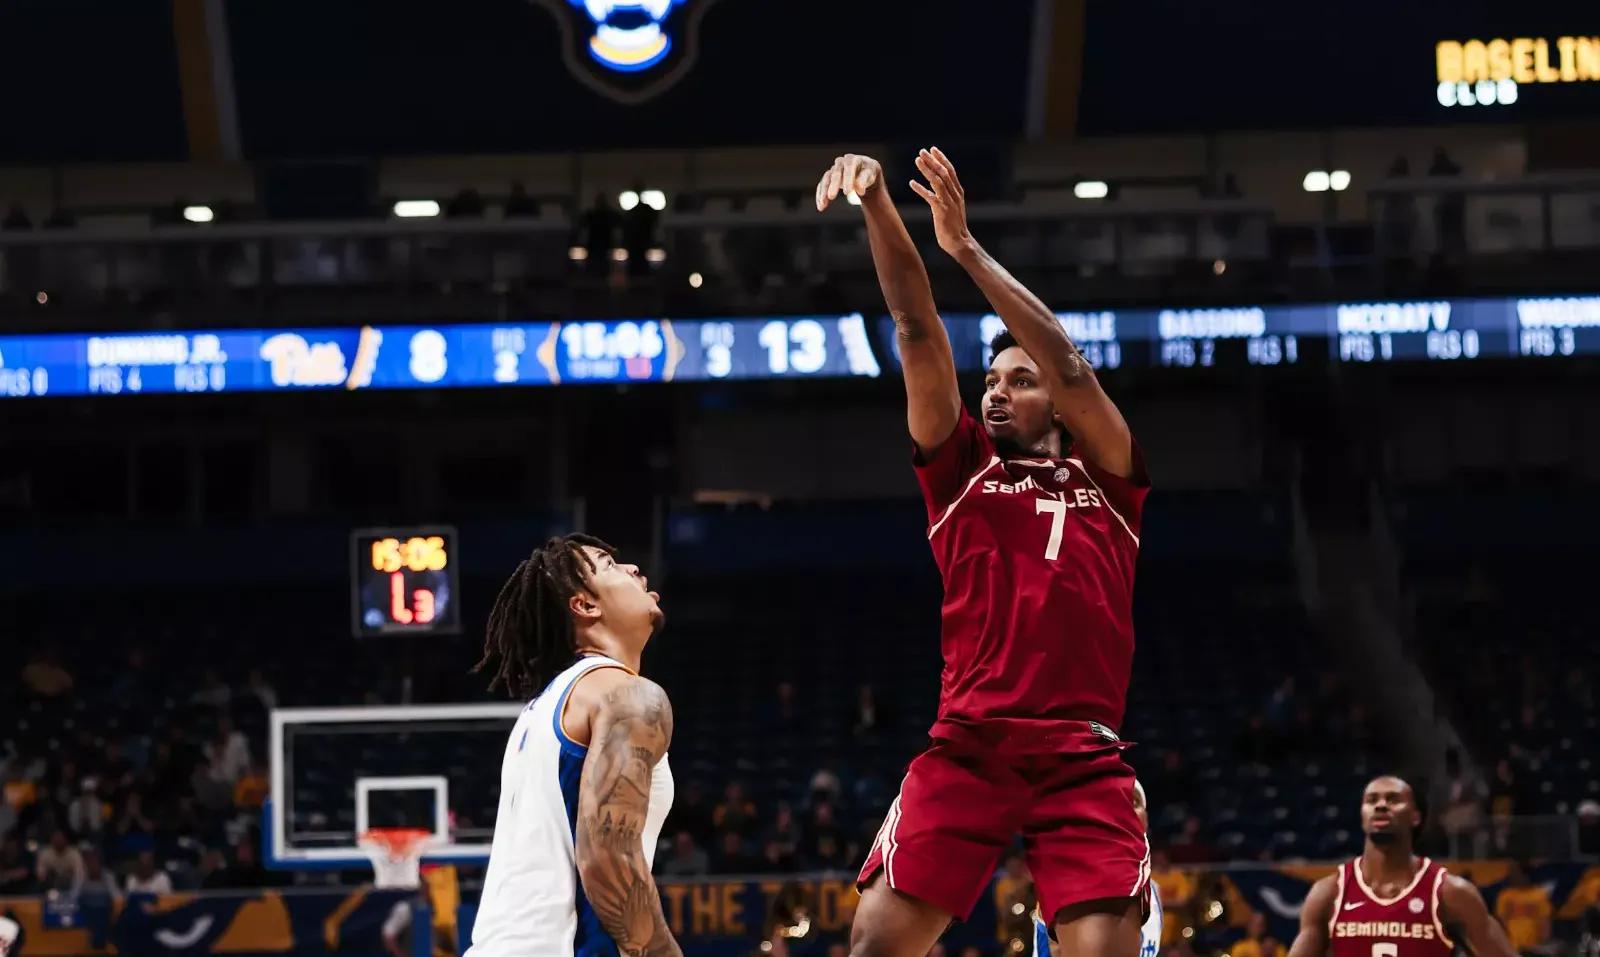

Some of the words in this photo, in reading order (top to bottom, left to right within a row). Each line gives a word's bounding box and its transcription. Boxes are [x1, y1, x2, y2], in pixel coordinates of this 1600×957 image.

[1437, 79, 1518, 106] CLUB
[410, 330, 447, 382] 8
[561, 321, 663, 359] 15:06
[759, 320, 827, 374] 13
[1200, 337, 1215, 366] 2
[1285, 335, 1297, 364] 1
[1380, 332, 1392, 360] 1
[494, 351, 518, 382] 2
[707, 345, 732, 377] 3
[127, 366, 142, 391] 4
[982, 475, 1101, 508] SEMLES
[1036, 498, 1066, 560] 7
[372, 536, 447, 572] 15:06
[664, 884, 746, 936] THE
[1336, 922, 1435, 939] SEMINOLES
